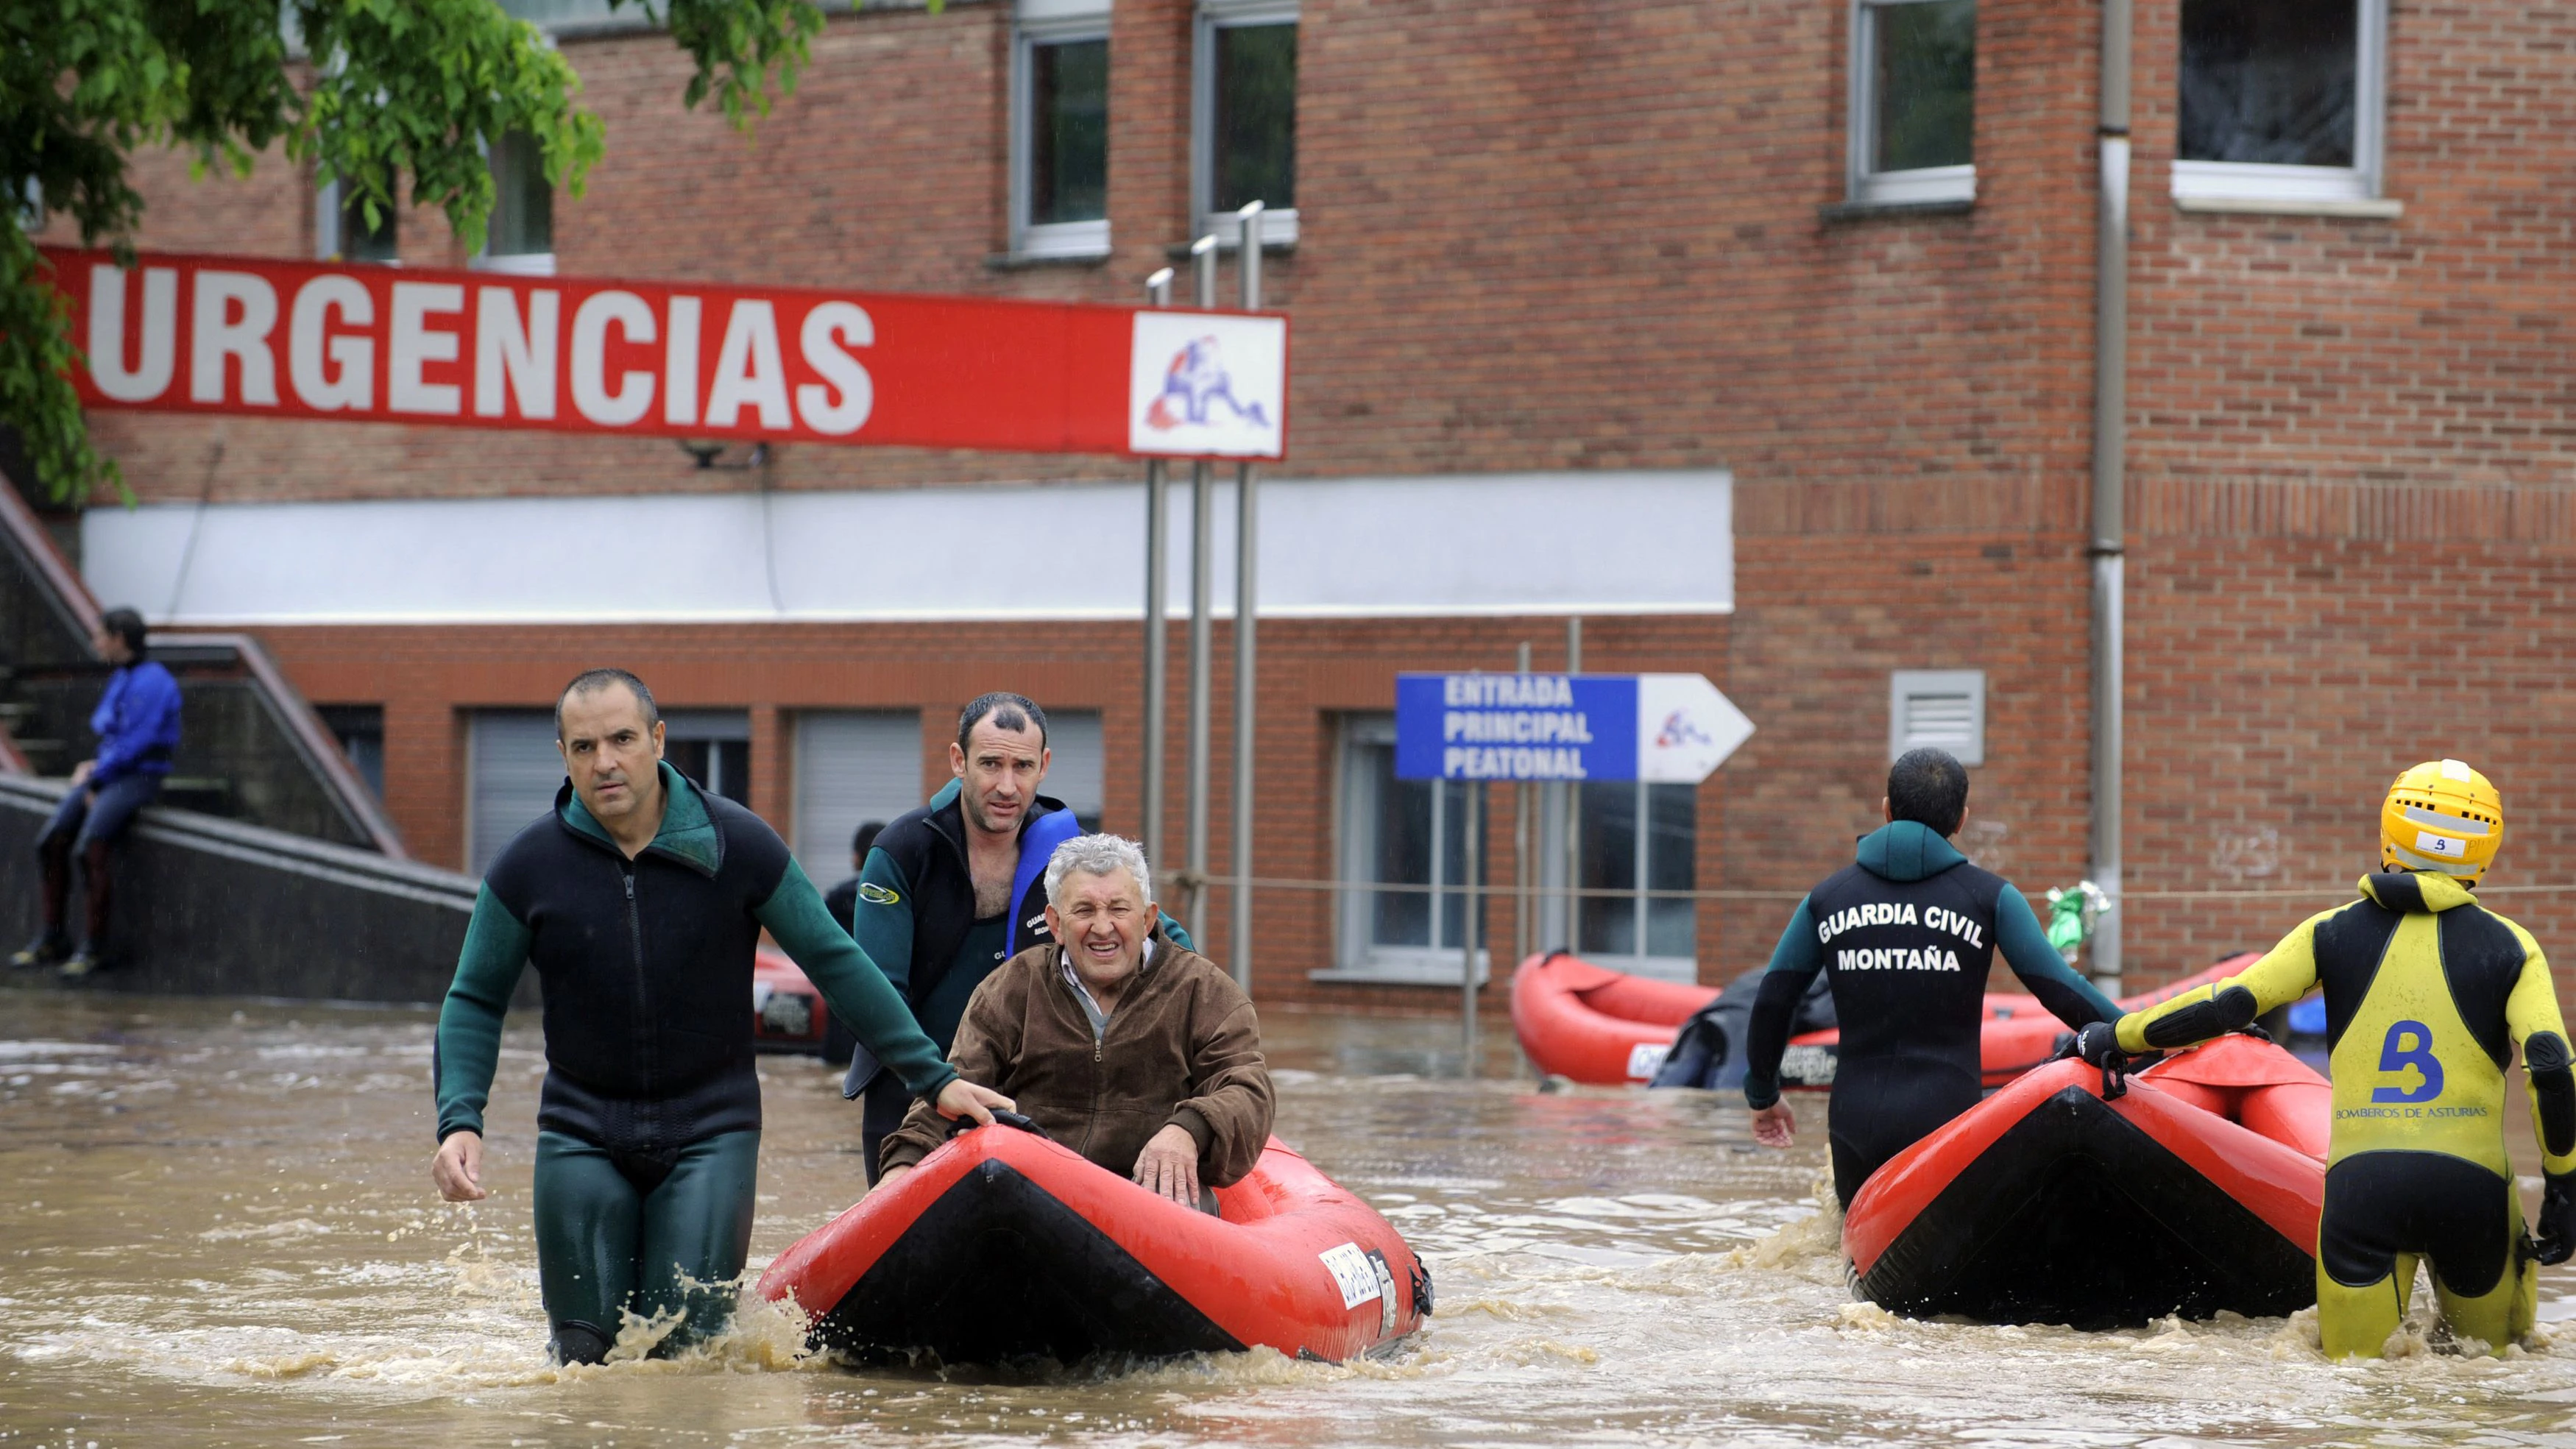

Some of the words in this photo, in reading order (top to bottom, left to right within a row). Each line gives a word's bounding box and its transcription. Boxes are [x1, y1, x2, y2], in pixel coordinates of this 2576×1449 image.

[89, 263, 874, 436] URGENCIAS
[1443, 676, 1574, 707] ENTRADA
[1443, 711, 1593, 744] PRINCIPAL
[1443, 747, 1588, 779] PEATONAL
[1818, 903, 1918, 945] GUARDIA
[1924, 906, 1984, 950] CIVIL
[1838, 946, 1961, 972] MONTAÑA
[2371, 1020, 2444, 1104] B
[2336, 1108, 2399, 1120] BOMBEROS
[2405, 1108, 2422, 1119] DE
[2427, 1107, 2488, 1118] ASTURIAS
